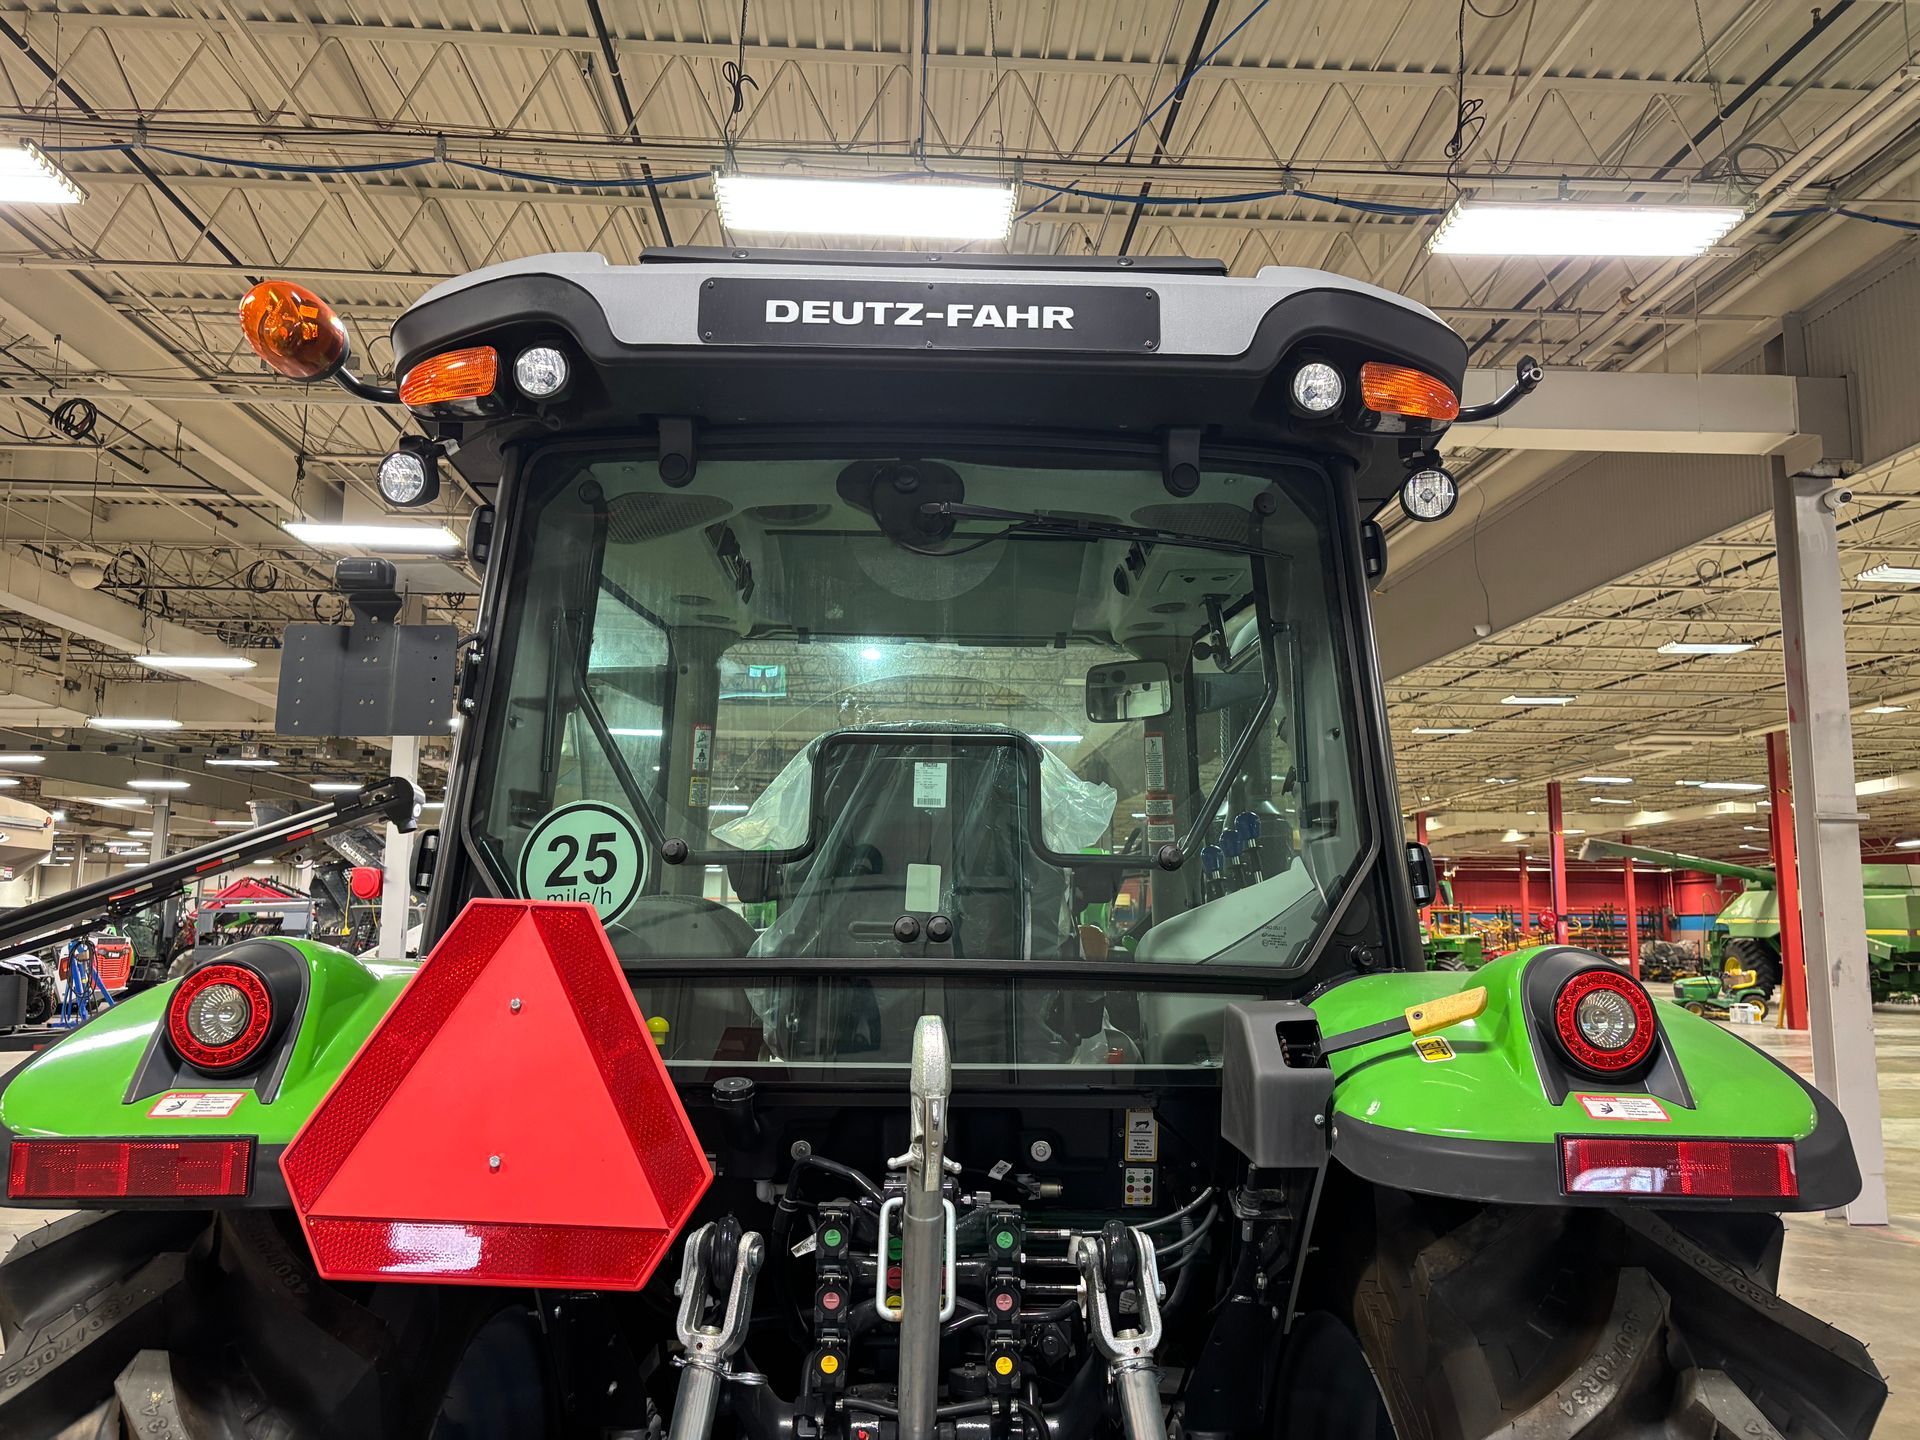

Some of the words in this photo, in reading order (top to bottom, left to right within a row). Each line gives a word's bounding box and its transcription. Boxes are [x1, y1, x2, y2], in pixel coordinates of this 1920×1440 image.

[765, 299, 1074, 330] DEUTZ-FAHR
[341, 842, 366, 865] DEERE
[545, 832, 617, 887] 25
